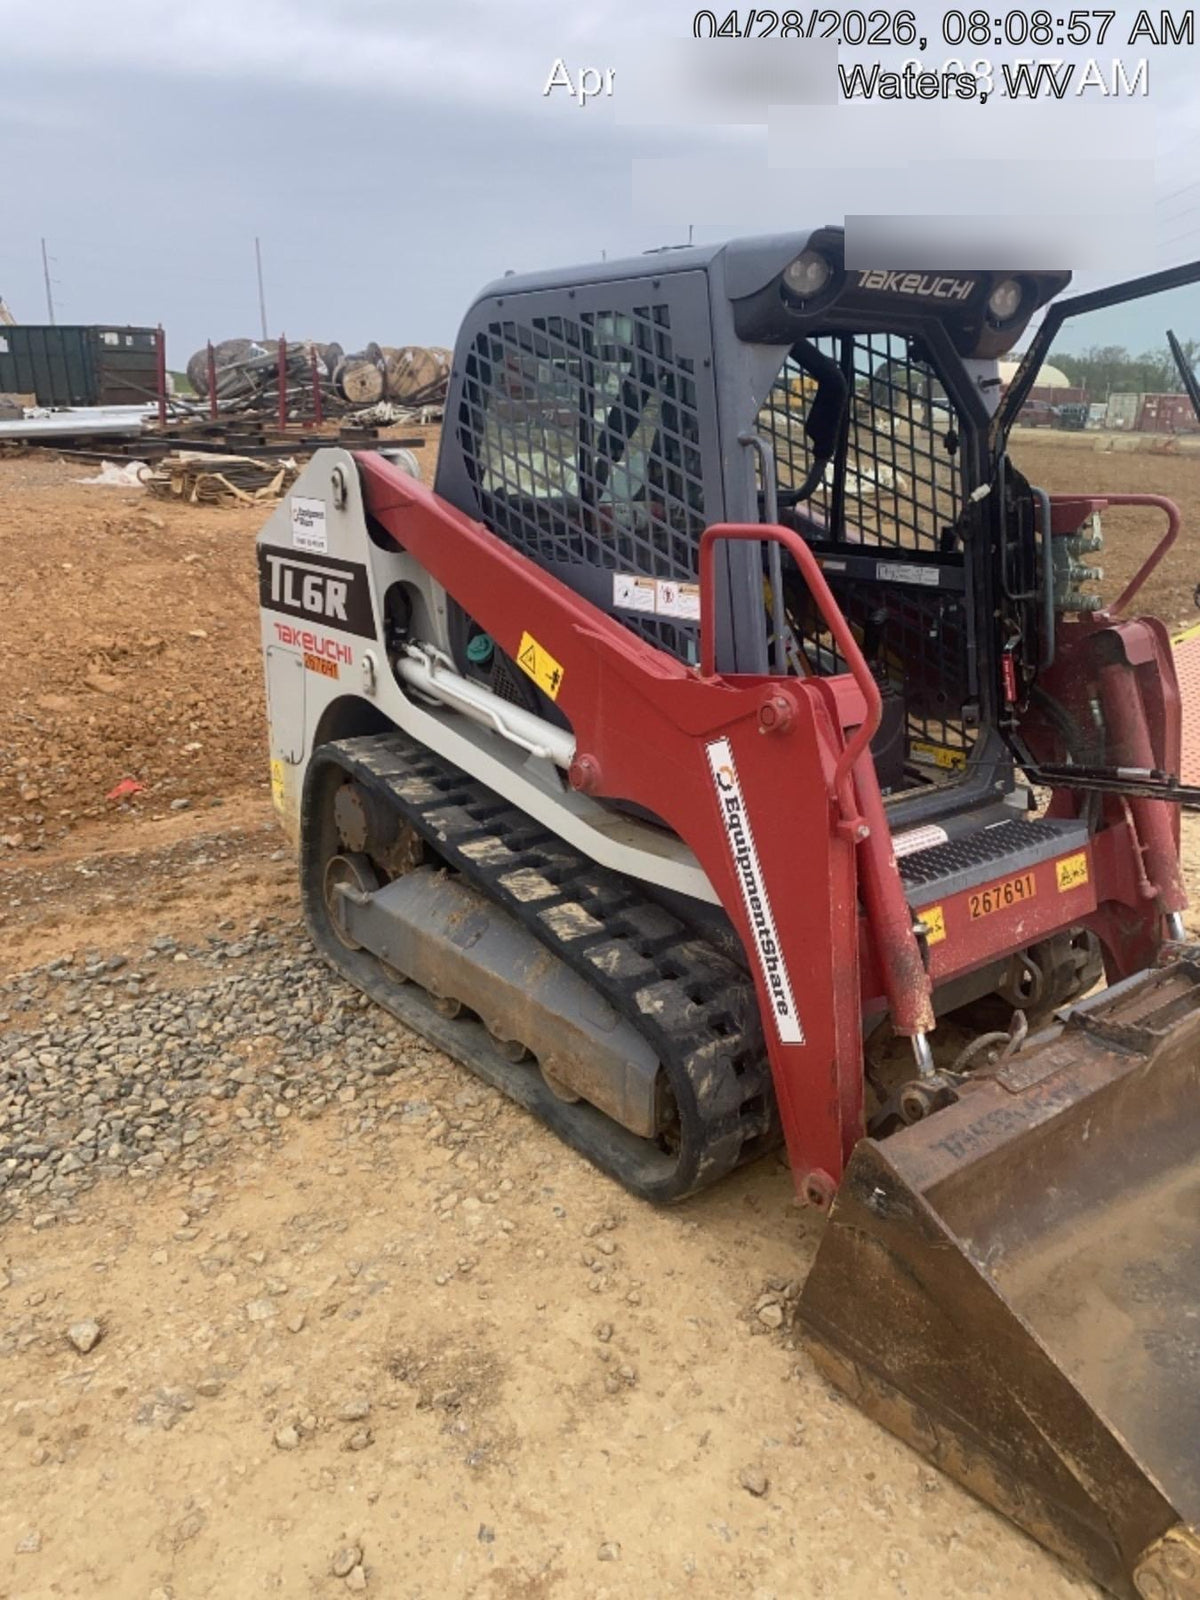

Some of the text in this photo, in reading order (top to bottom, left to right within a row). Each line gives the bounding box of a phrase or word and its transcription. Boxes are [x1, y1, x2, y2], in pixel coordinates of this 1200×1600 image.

[266, 555, 354, 621] TL6R
[725, 796, 789, 1017] EquipmentShare
[970, 875, 1032, 918] 267691
